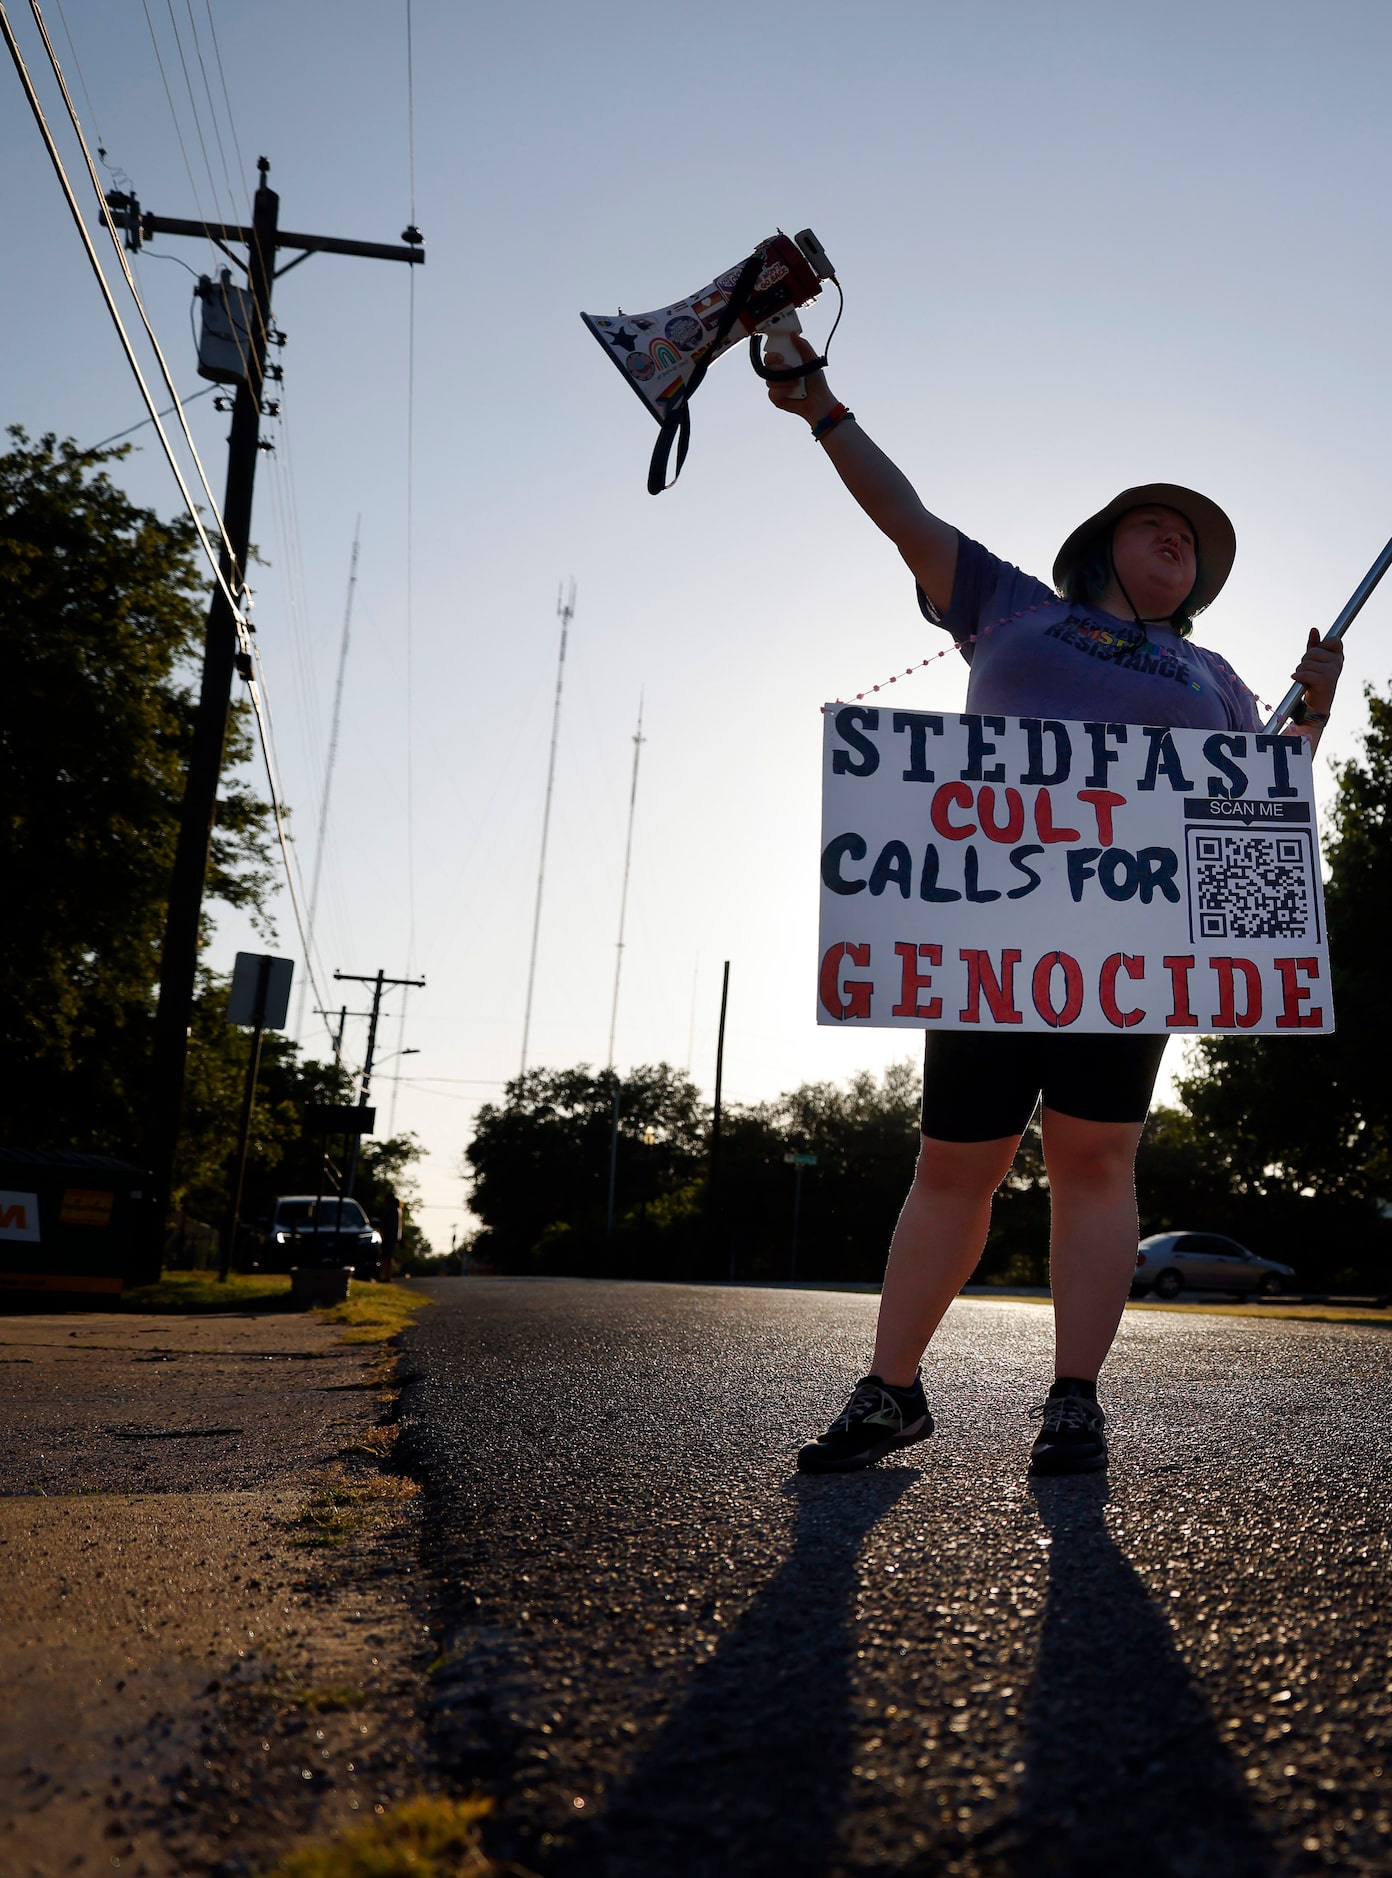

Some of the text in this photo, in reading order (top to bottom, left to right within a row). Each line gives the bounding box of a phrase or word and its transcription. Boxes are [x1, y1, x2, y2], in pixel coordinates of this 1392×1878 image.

[1044, 622, 1188, 686] RESISTANCE
[832, 706, 1302, 799] STEDFAST
[930, 781, 1128, 847] CULT
[1209, 800, 1284, 817] SCAN ME
[820, 832, 1181, 905] CALLS FOR
[819, 941, 1324, 1028] GENOCIDE
